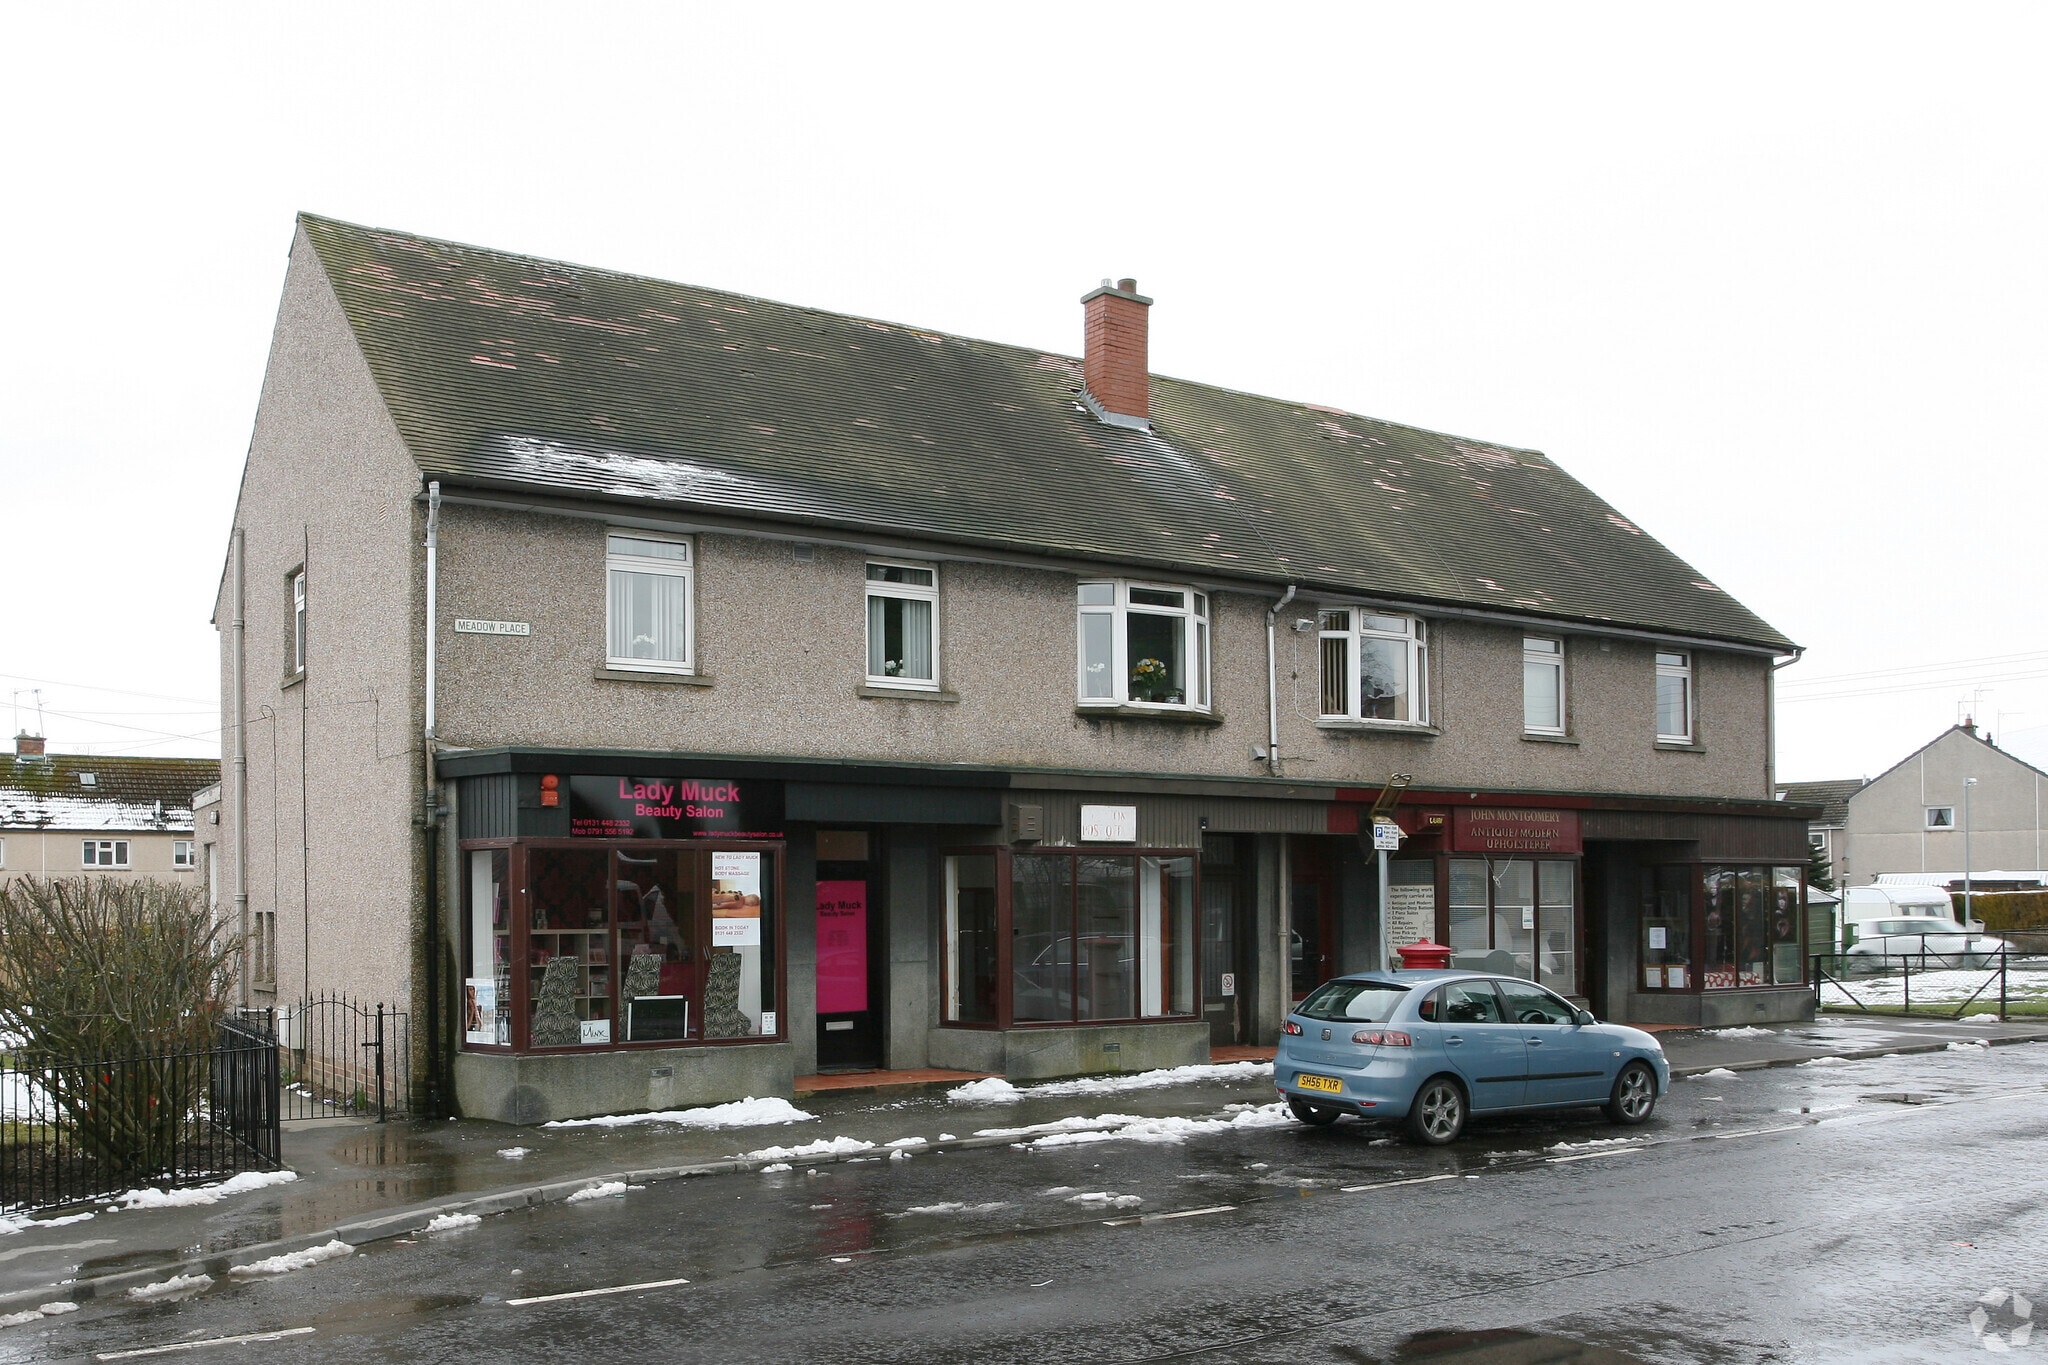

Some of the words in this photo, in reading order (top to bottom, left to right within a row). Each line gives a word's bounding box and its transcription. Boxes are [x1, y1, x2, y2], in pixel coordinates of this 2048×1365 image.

[458, 620, 496, 632] MEADOW
[499, 623, 526, 634] PLACE
[618, 778, 675, 806] Lady
[681, 780, 741, 802] Muck
[635, 803, 682, 820] Beauty
[686, 804, 724, 818] Salon
[1470, 808, 1495, 823] JOHN
[1497, 809, 1561, 822] MONTGOMERY
[1520, 828, 1559, 839] MODERN
[1486, 839, 1551, 850] UPHOLSTERER
[838, 900, 862, 909] Muck
[1301, 1075, 1321, 1088] SH56
[1323, 1076, 1339, 1090] TXR
